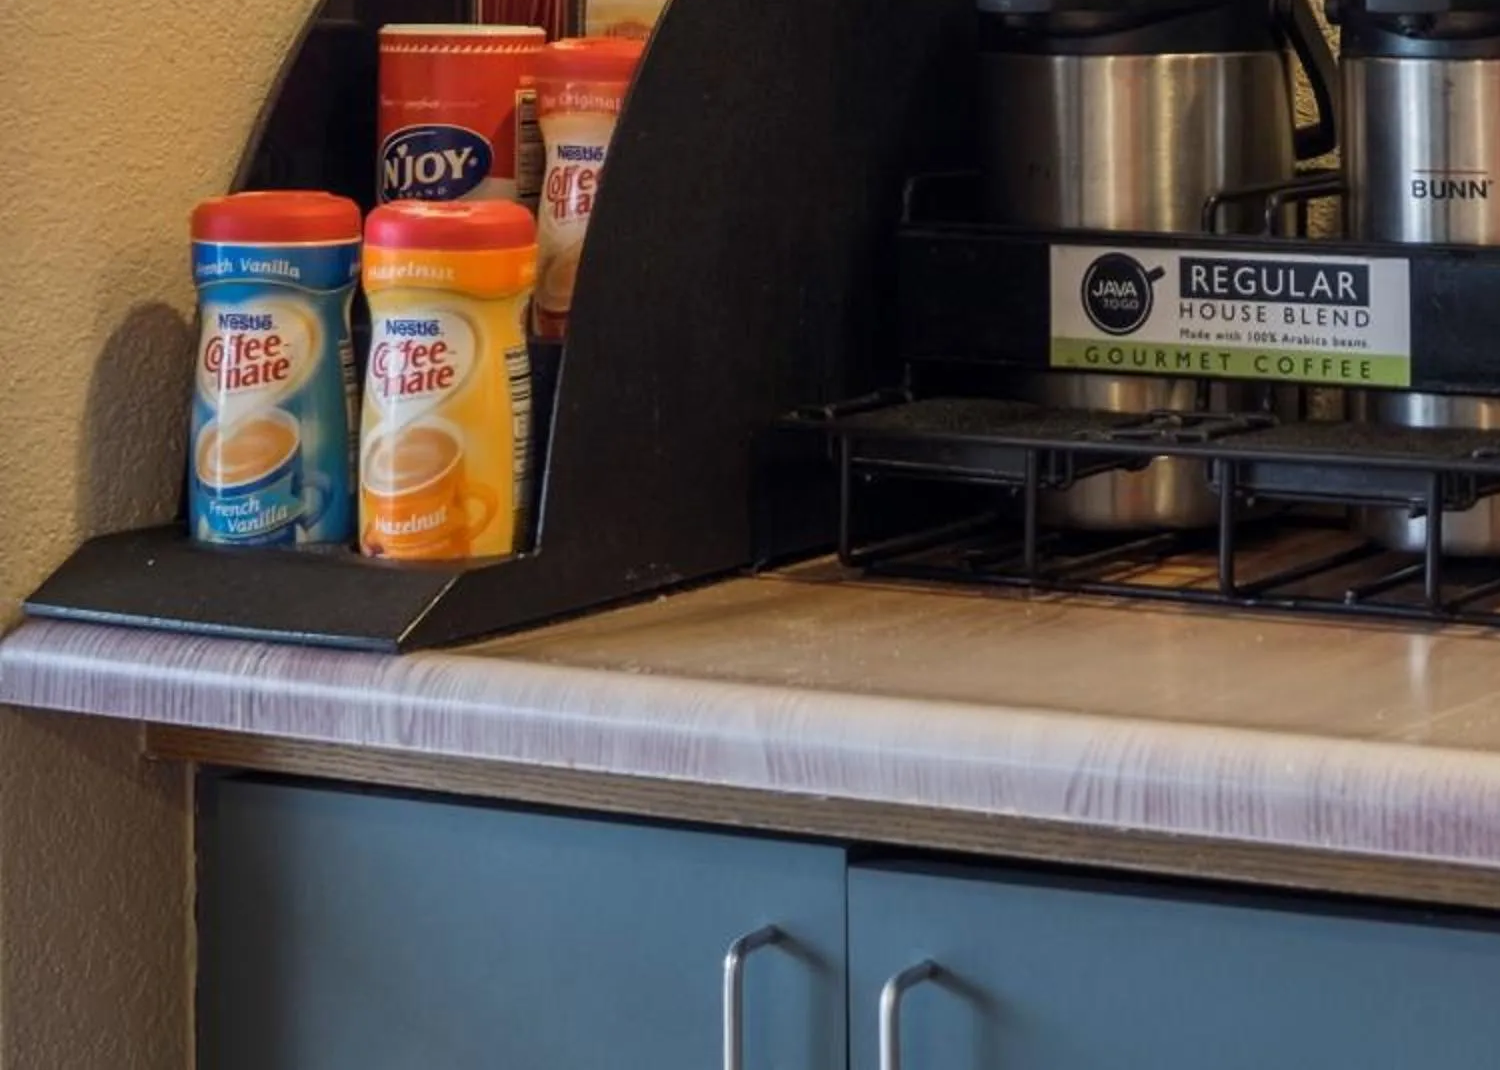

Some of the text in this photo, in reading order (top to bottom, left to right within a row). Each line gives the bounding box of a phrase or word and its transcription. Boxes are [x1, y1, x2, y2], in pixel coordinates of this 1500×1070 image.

[1411, 179, 1490, 200] BUNN
[240, 258, 300, 279] Vanilla
[1092, 278, 1138, 298] JAVA
[1190, 264, 1358, 301] REGULAR
[1179, 302, 1370, 328] HOUSE BLEND
[1180, 328, 1212, 340] Made
[1216, 330, 1241, 341] with
[1248, 331, 1278, 343] 100%
[1281, 332, 1328, 347] Arabica
[1084, 345, 1372, 379] GOURMET COFFEE
[209, 497, 261, 518] French
[227, 505, 289, 534] Vanilla
[375, 505, 448, 535] Hazelnut
